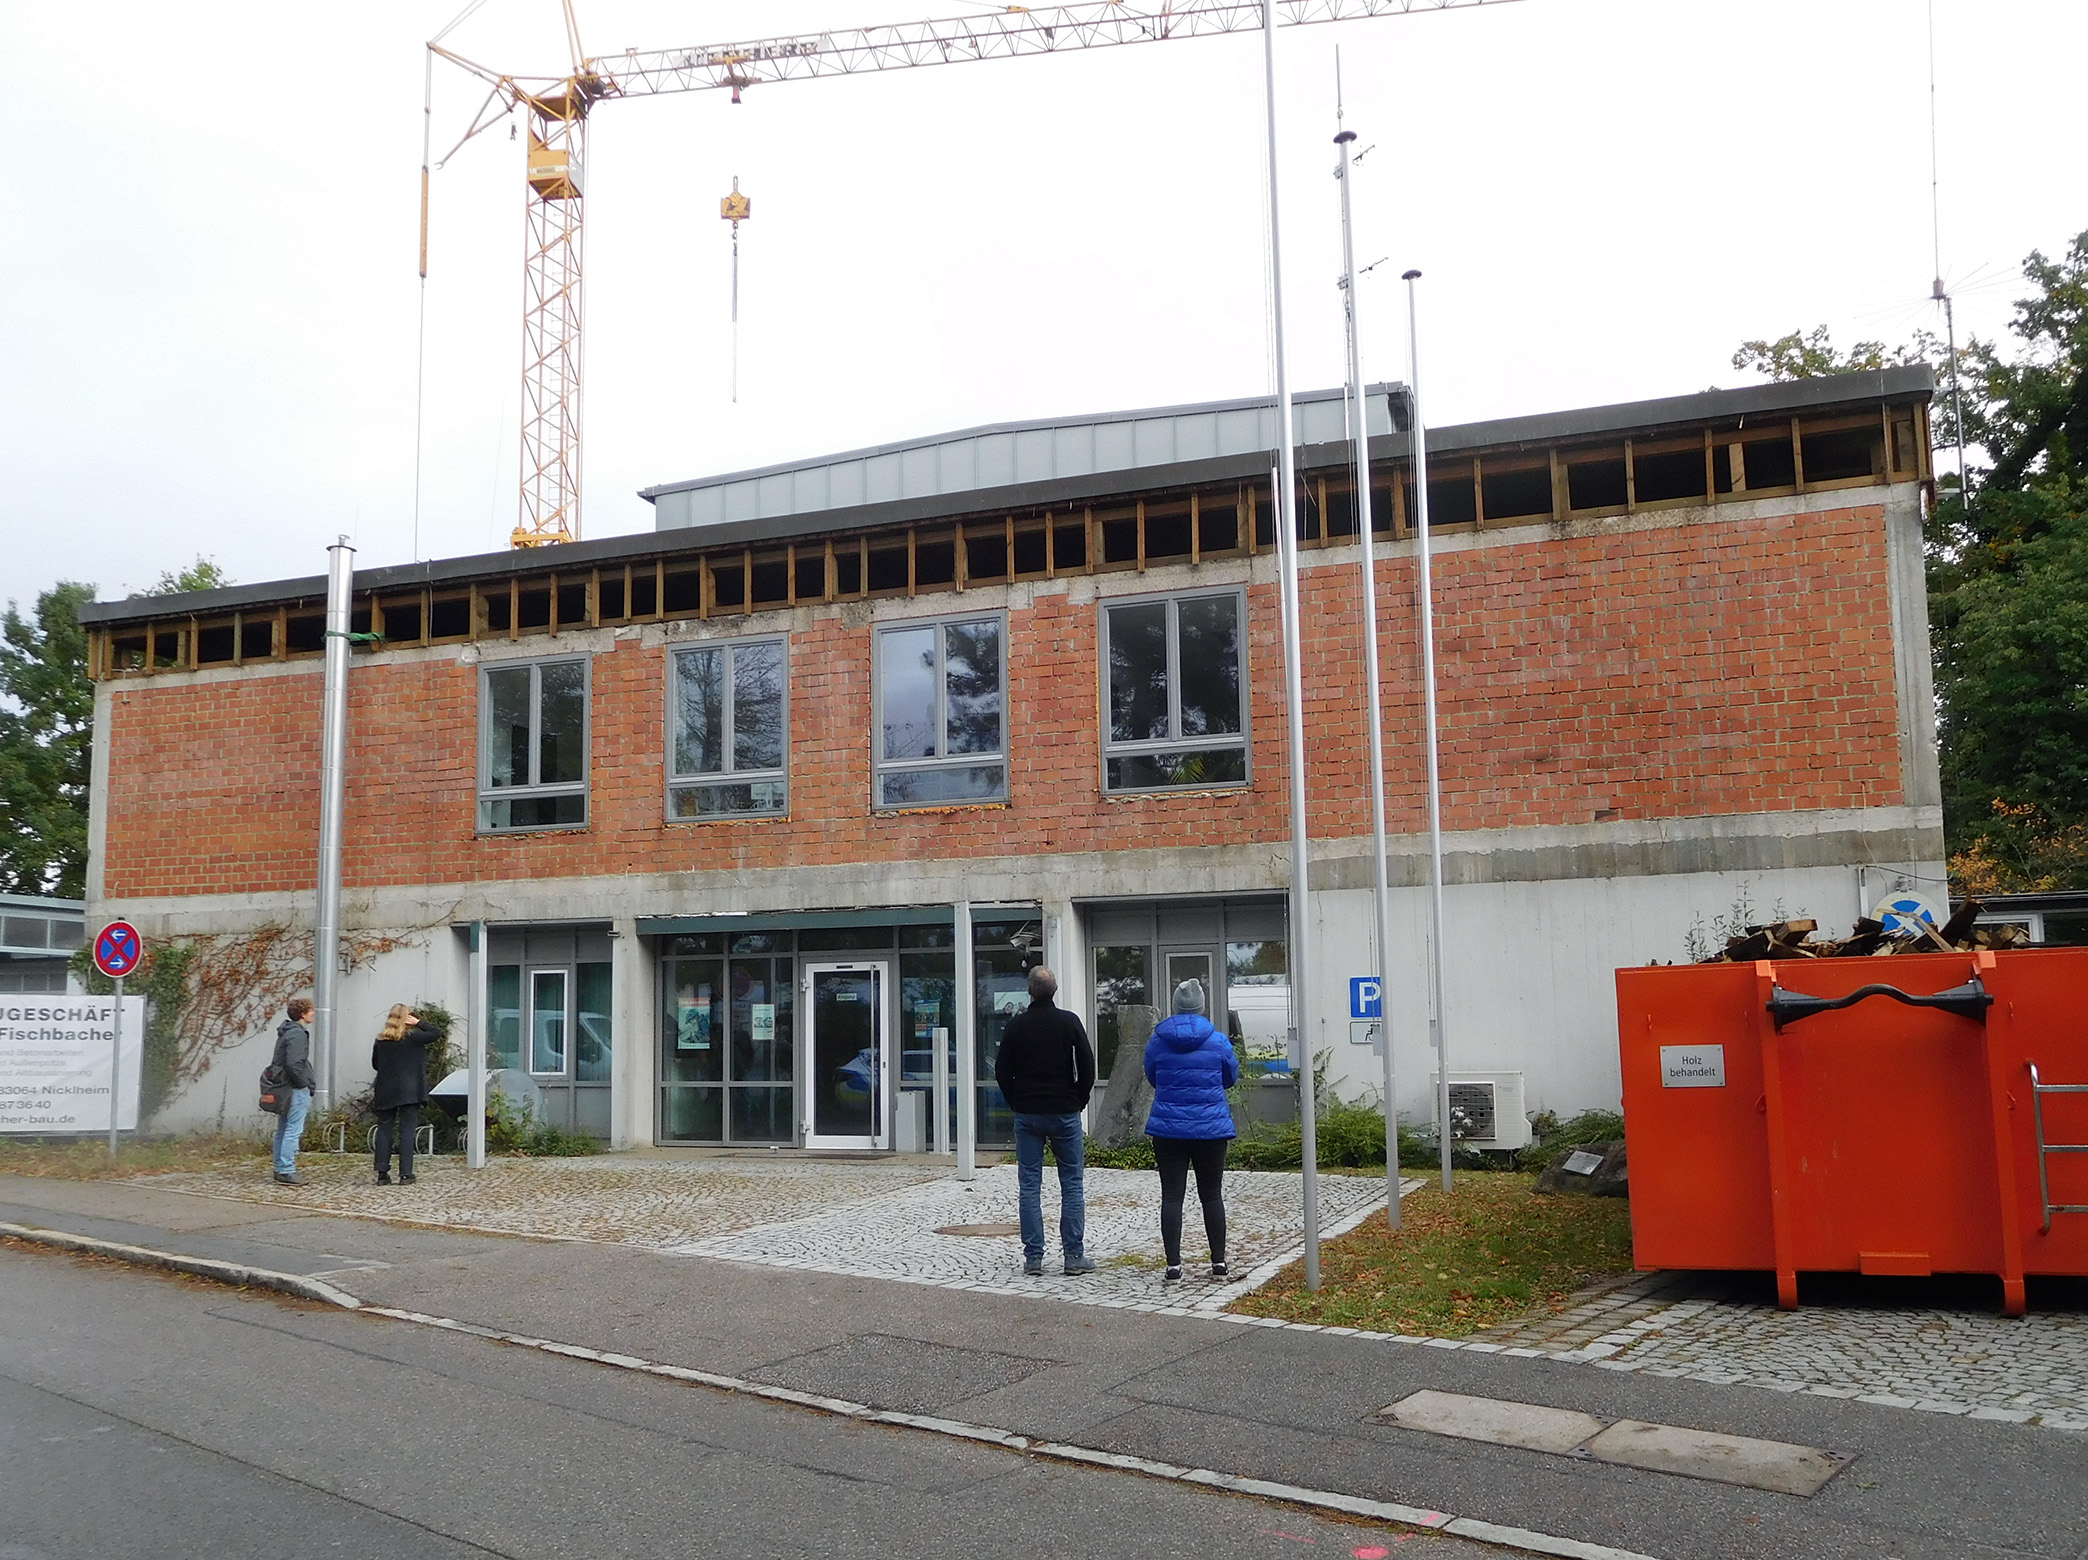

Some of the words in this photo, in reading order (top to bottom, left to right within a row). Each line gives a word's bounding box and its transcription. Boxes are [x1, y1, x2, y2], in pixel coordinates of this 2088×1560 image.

[1359, 982, 1381, 1013] P
[0, 1027, 122, 1041] Fischbache
[1681, 1056, 1702, 1065] Holz
[1669, 1067, 1716, 1077] behandelt
[41, 1085, 110, 1095] Nicklheim
[0, 1115, 76, 1124] her-bau.de
